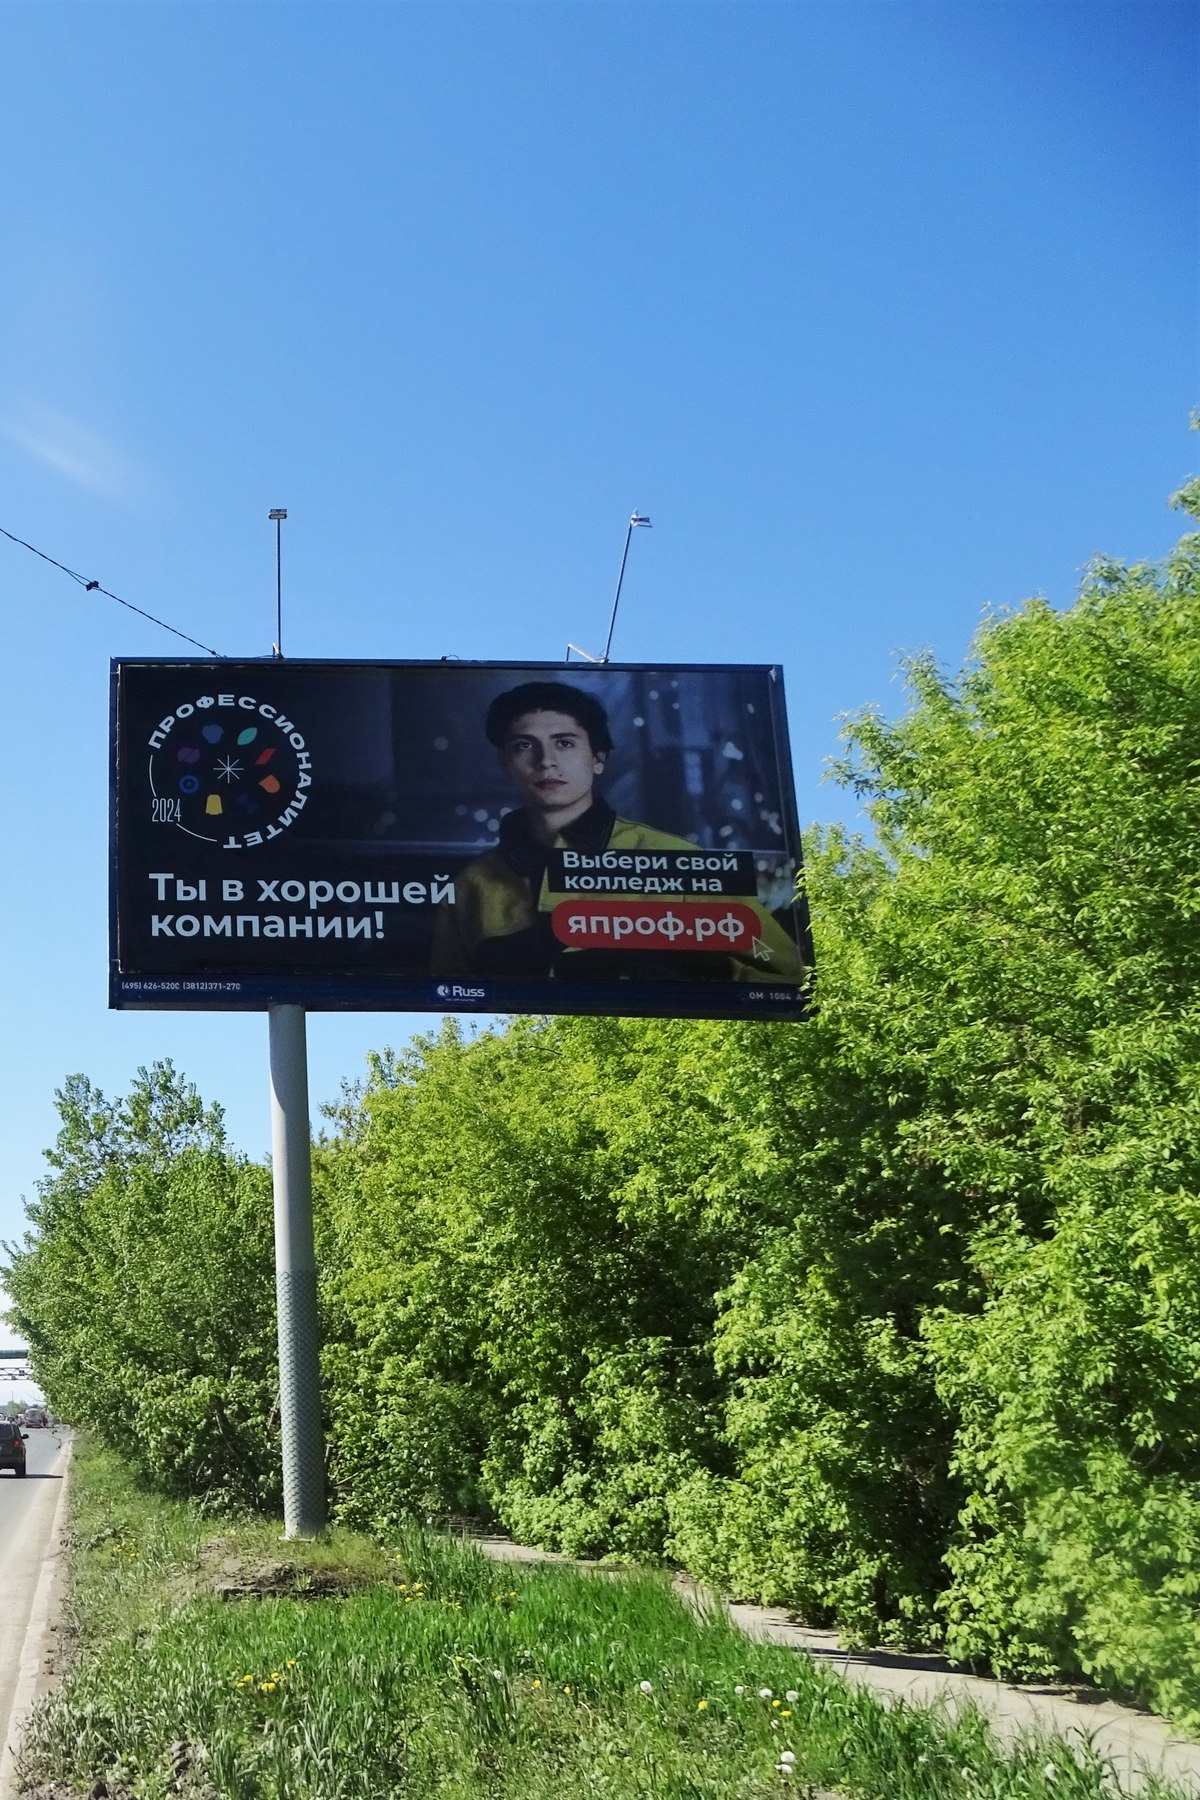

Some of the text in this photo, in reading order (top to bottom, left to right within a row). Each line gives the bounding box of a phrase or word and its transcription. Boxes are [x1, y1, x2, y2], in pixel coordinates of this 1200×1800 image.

[148, 694, 312, 849] ПРОФЕССИОНАЛИТЕТ
[151, 797, 182, 823] 2024
[562, 850, 738, 874] Выбери свой
[148, 872, 456, 910] Ты в хорошей
[564, 875, 723, 893] колледж на
[151, 911, 385, 939] компании!
[567, 911, 745, 943] япроф.рф
[452, 985, 485, 997] Russ
